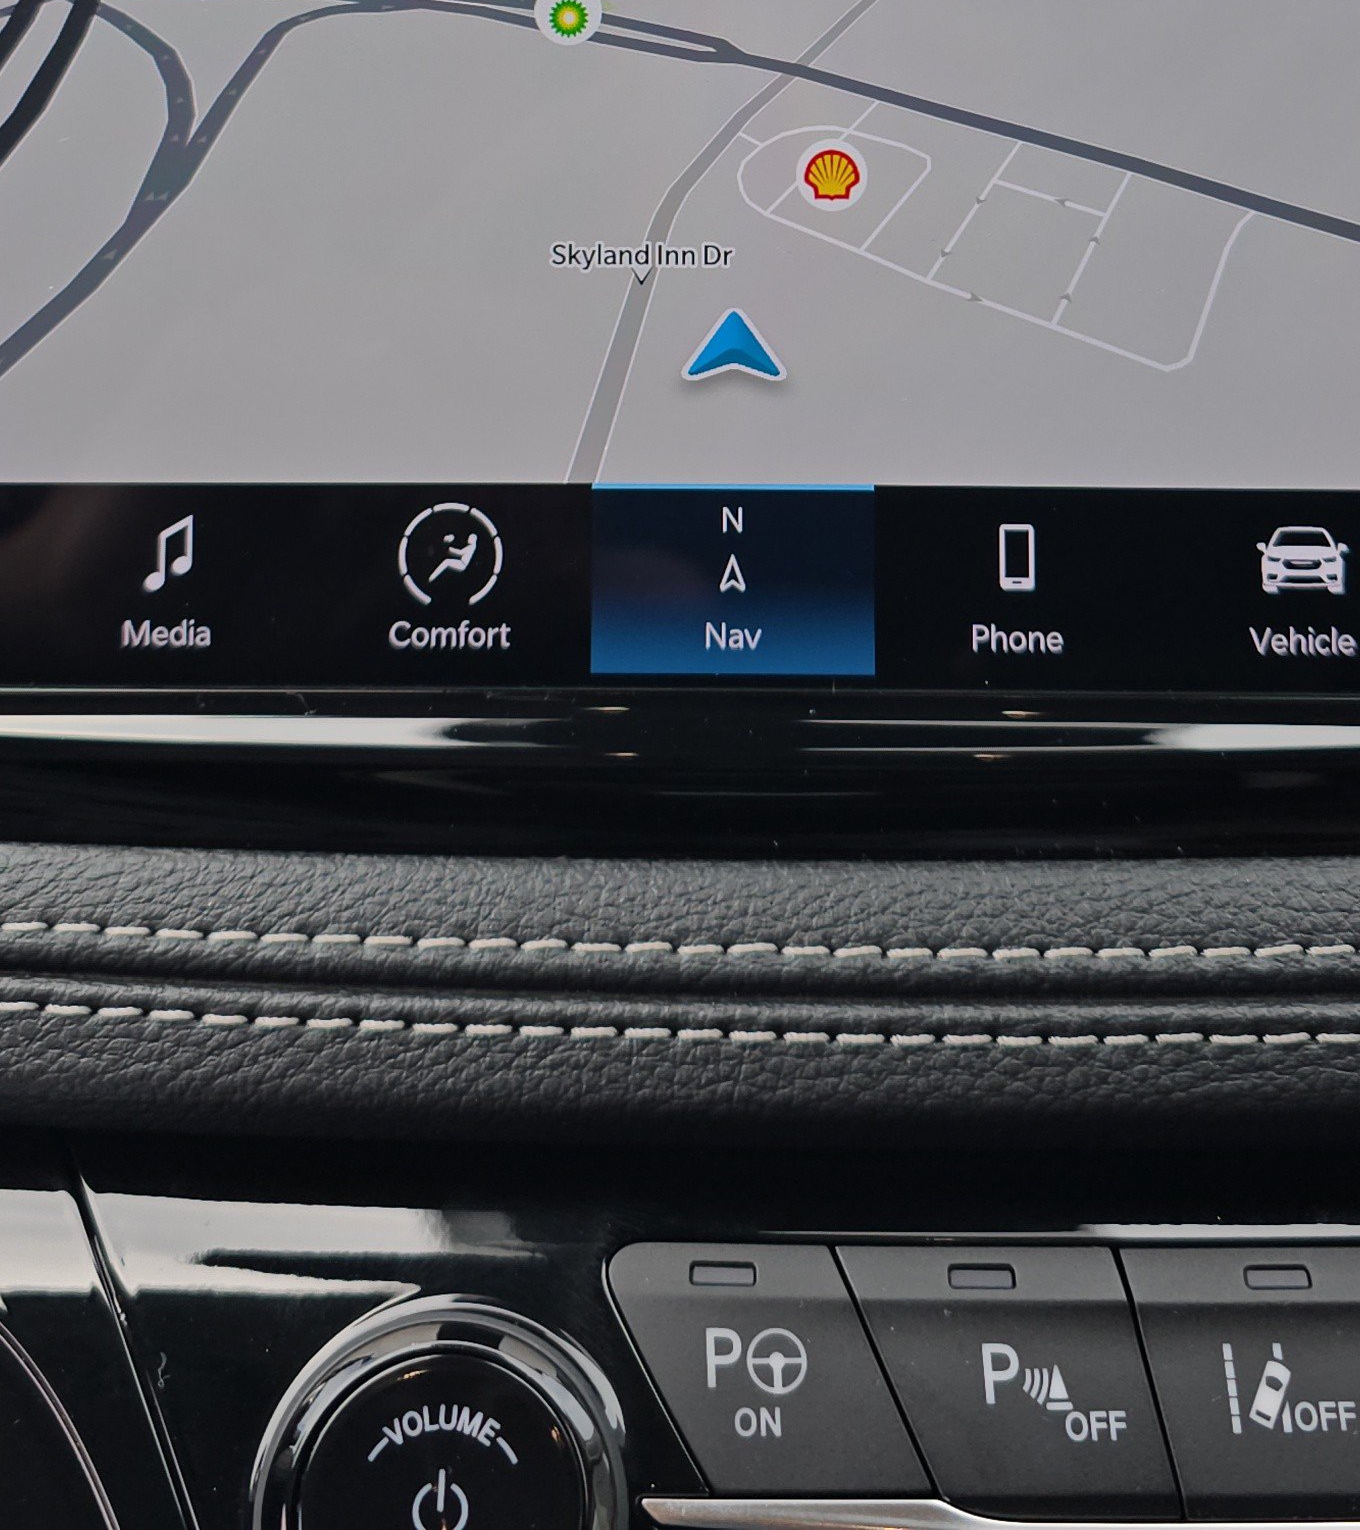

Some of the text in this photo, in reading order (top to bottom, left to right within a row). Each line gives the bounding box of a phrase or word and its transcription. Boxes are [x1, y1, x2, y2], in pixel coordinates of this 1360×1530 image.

[551, 243, 733, 269] Skyland Inn Dr
[721, 507, 743, 533] N
[120, 620, 212, 649] Media
[388, 620, 511, 651] Comfort
[704, 622, 762, 651] Nav
[970, 624, 1065, 654] Phone
[1249, 626, 1357, 657] Vehicle
[382, 1404, 502, 1447] VOLUME
[734, 1407, 782, 1438] ON
[1065, 1410, 1128, 1441] OFF
[1295, 1400, 1357, 1432] OFF
